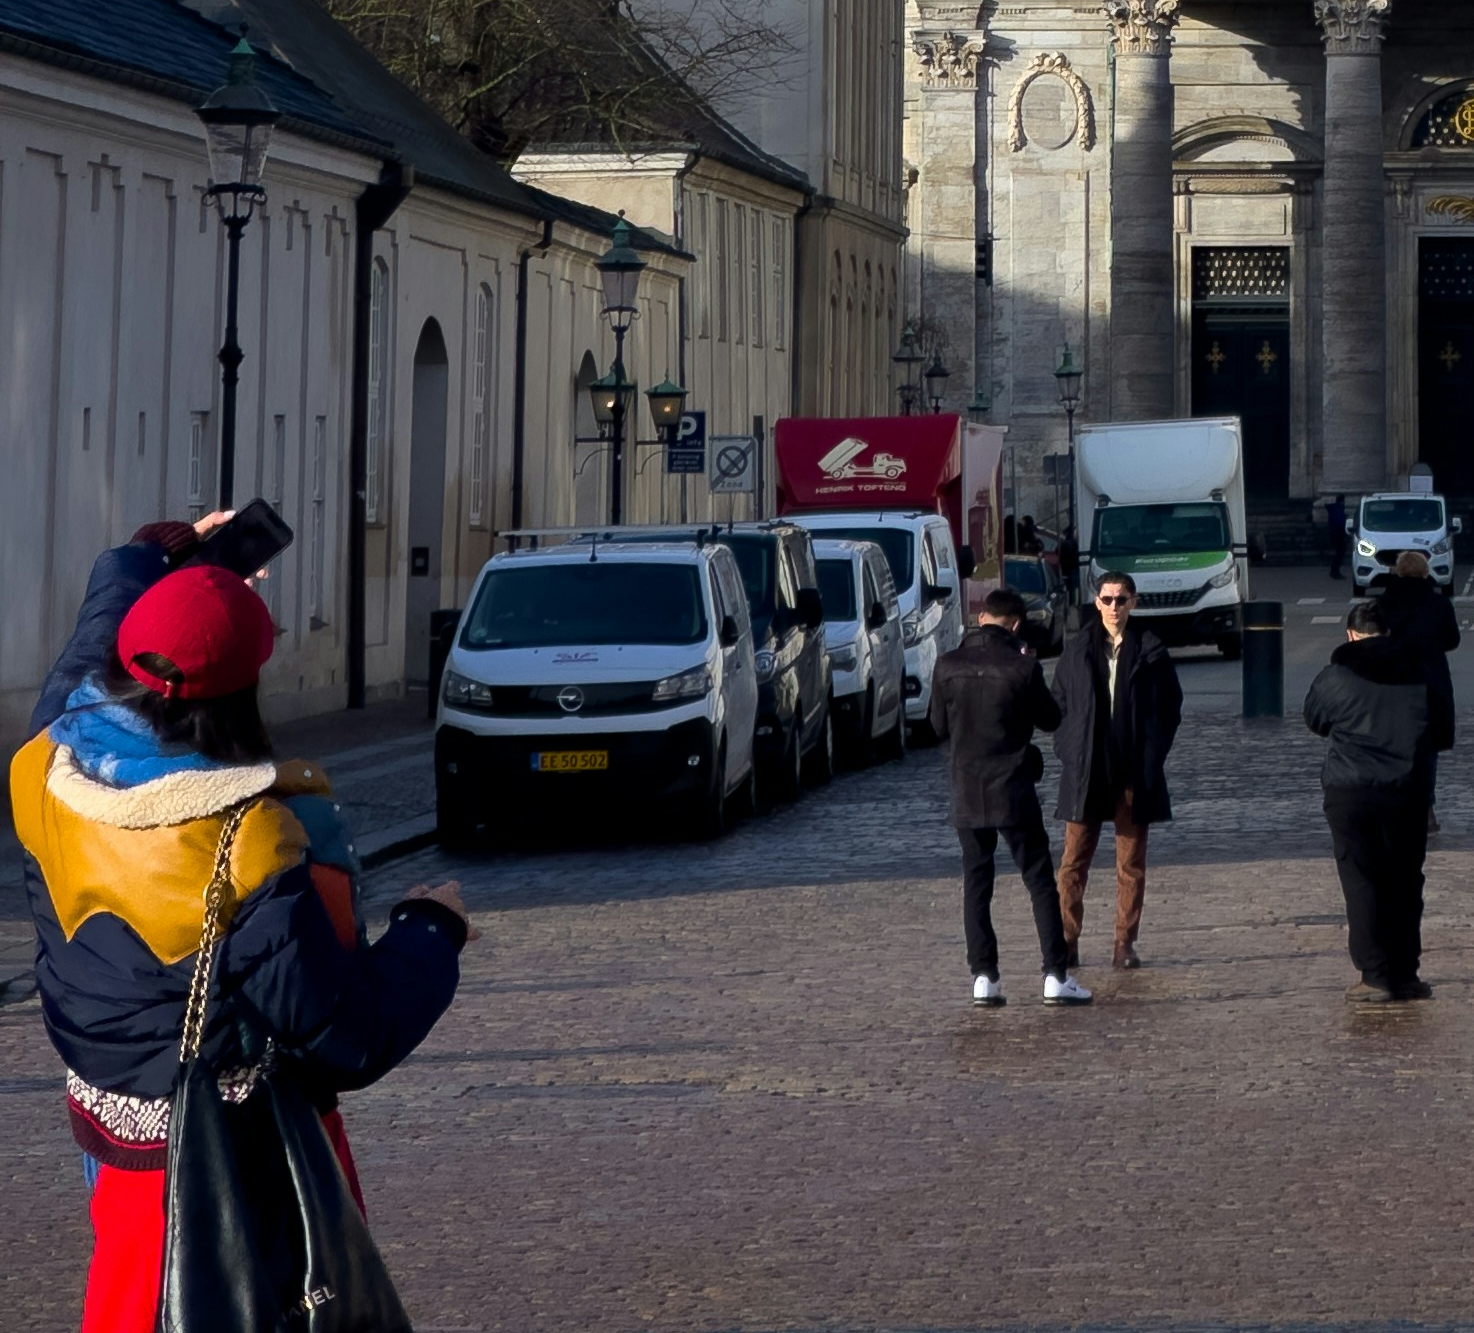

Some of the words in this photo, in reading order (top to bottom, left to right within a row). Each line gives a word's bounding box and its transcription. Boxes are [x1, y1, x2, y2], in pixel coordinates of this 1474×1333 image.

[677, 416, 697, 441] P
[561, 754, 578, 767] 50
[581, 753, 606, 766] 502
